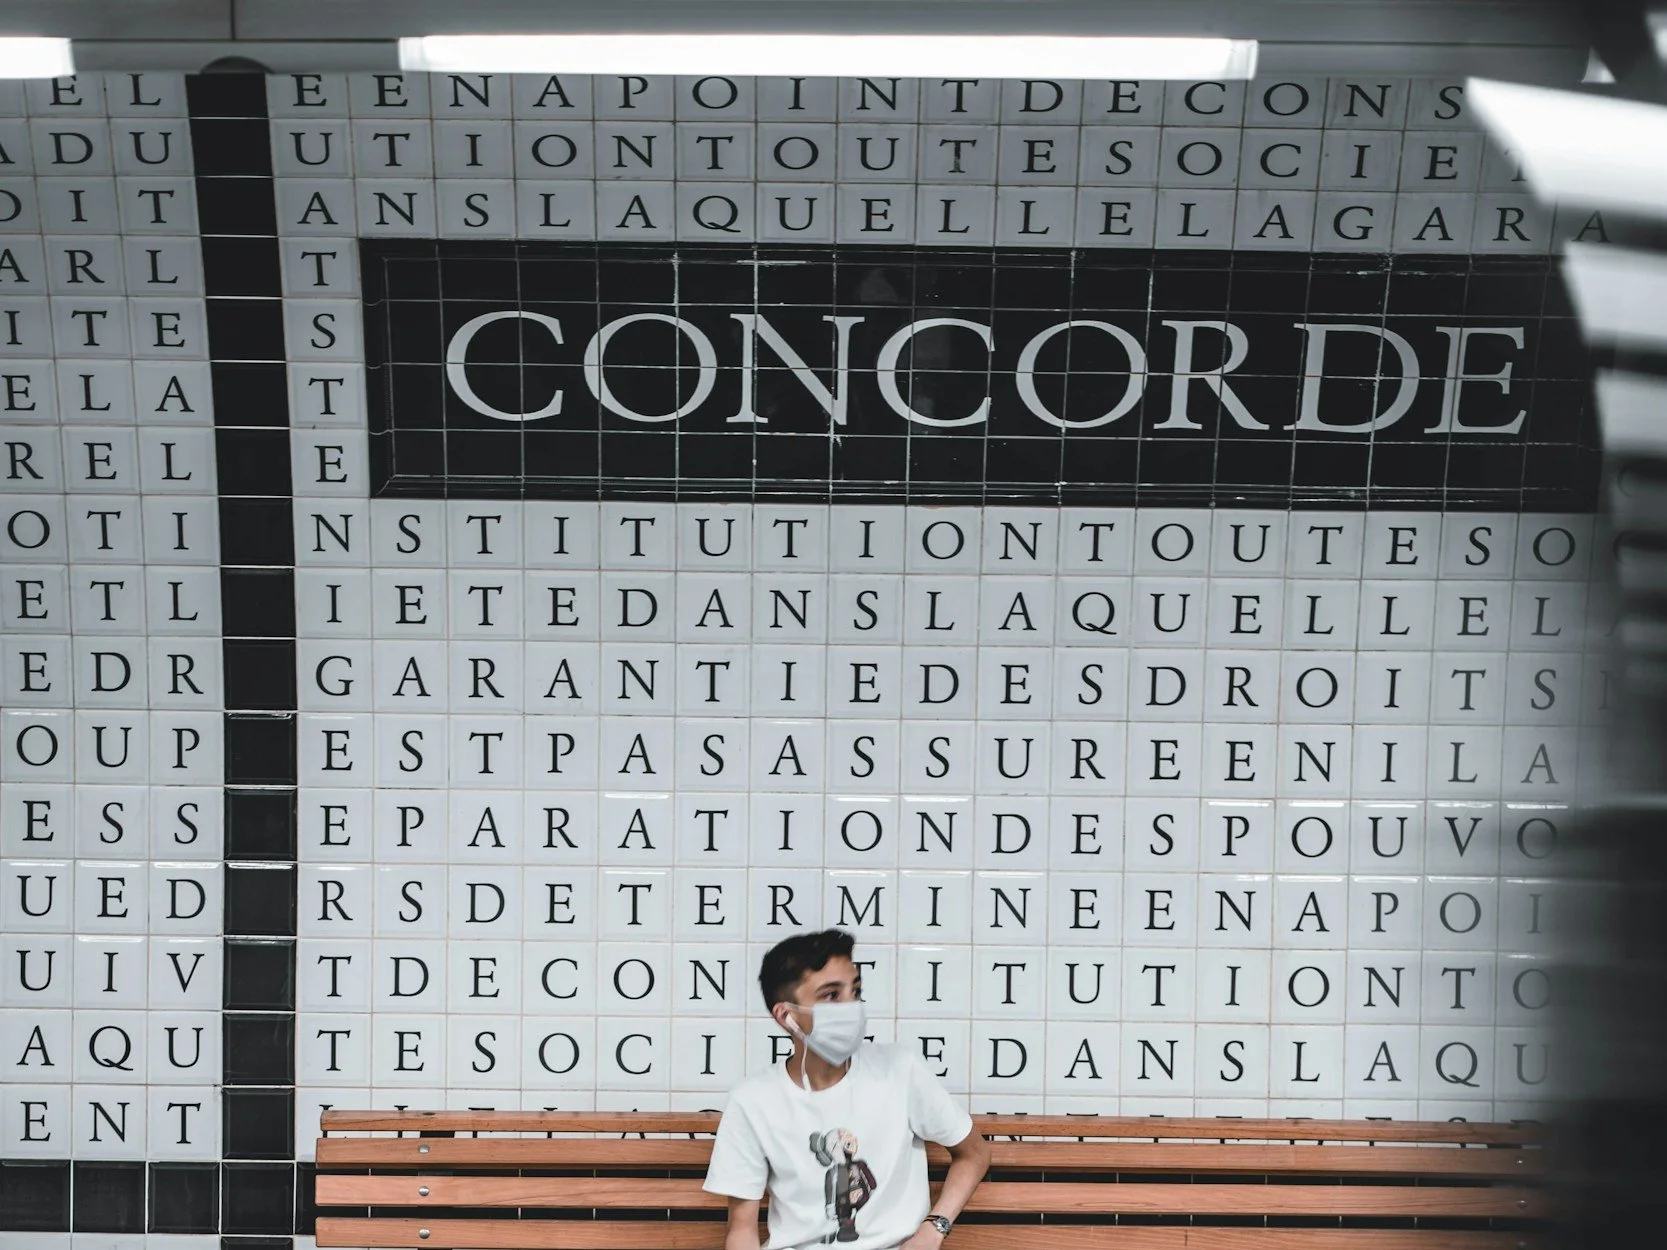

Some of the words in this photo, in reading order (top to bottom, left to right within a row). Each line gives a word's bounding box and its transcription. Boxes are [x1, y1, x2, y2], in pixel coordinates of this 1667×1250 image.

[49, 74, 161, 106] EL
[291, 74, 1464, 120] EENAPOINTDECONS
[290, 133, 1526, 182] UTIONTOUTESOCIE
[301, 251, 337, 287] T
[4, 310, 186, 348] ITE
[311, 313, 336, 349] S
[446, 310, 1527, 434] CONCORDE
[1, 375, 195, 413] ELA
[308, 377, 344, 416] T
[4, 442, 191, 481] REL
[314, 446, 348, 485] E
[7, 509, 189, 551] OTI
[311, 513, 1576, 567] NSTITUTIONTOUTESO
[16, 580, 199, 622] ETL
[19, 652, 204, 695] EDR
[16, 725, 200, 769] OUP
[22, 800, 199, 845] ESS
[17, 875, 205, 920] UED
[16, 950, 205, 994] UIV
[318, 956, 1549, 1010] TDECONITUTIONTO
[16, 1025, 203, 1072] AQU
[20, 1101, 201, 1145] ENT
